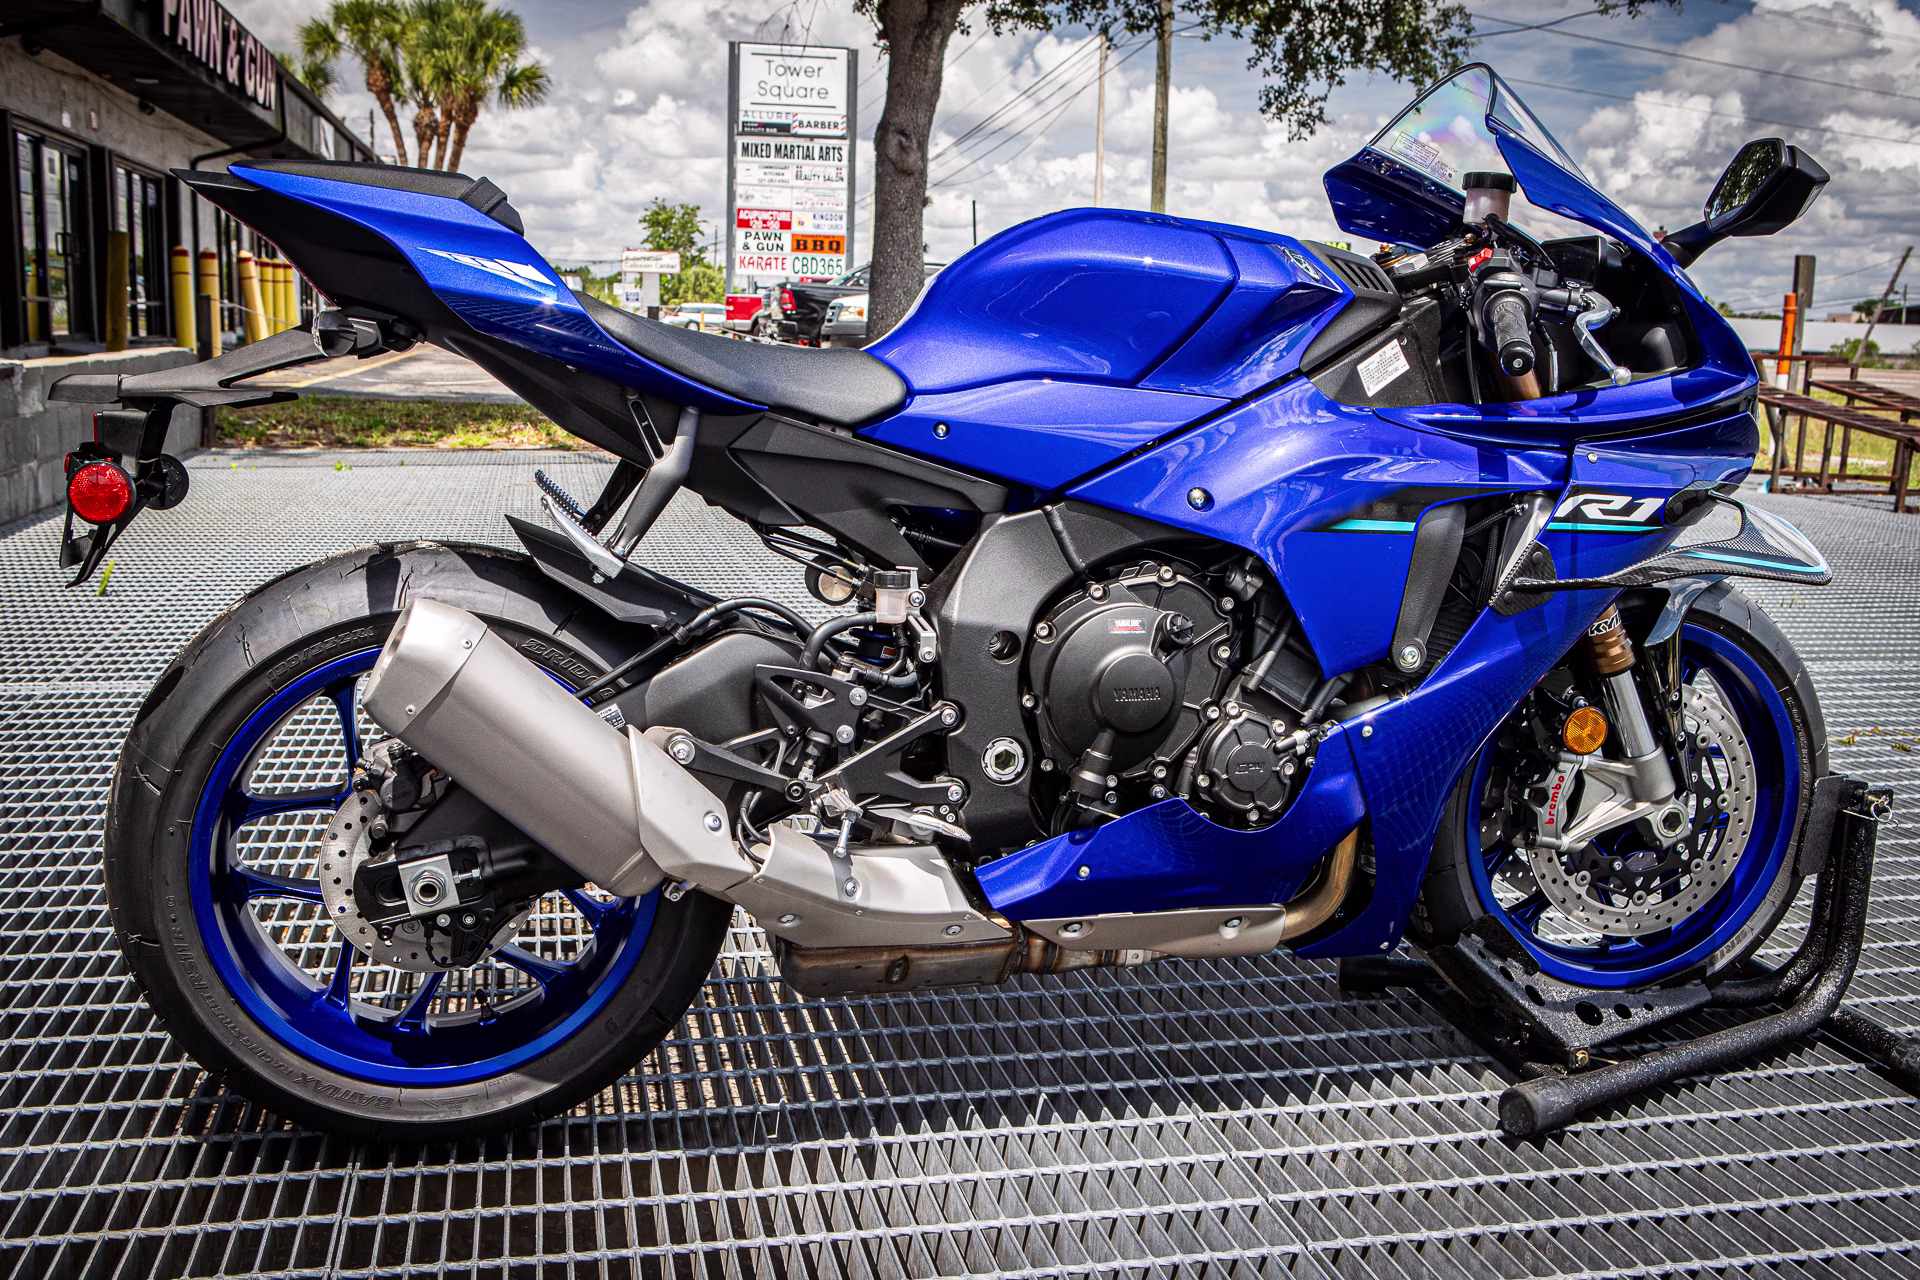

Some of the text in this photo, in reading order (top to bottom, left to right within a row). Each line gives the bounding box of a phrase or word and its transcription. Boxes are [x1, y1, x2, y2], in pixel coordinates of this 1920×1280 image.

[163, 0, 277, 111] PAWN & GUN
[765, 59, 823, 79] Tower
[758, 81, 829, 101] Square
[743, 111, 791, 120] ALLURE
[798, 120, 840, 130] BARBER
[741, 142, 843, 162] MIXED MARTIAL ARTS
[795, 173, 820, 181] BEAUTY
[739, 210, 792, 221] ACUPUNCTURE
[813, 213, 843, 221] KINGDOM
[744, 231, 782, 241] PAWN
[742, 242, 784, 252] & GUN
[795, 239, 841, 253] BBQ
[739, 255, 787, 271] KARATE
[792, 256, 843, 275] CBD365
[1554, 493, 1665, 522] R1
[1113, 686, 1161, 701] YAMAHA
[1544, 775, 1565, 825] brembo
[293, 1072, 395, 1111] BATTLAX
